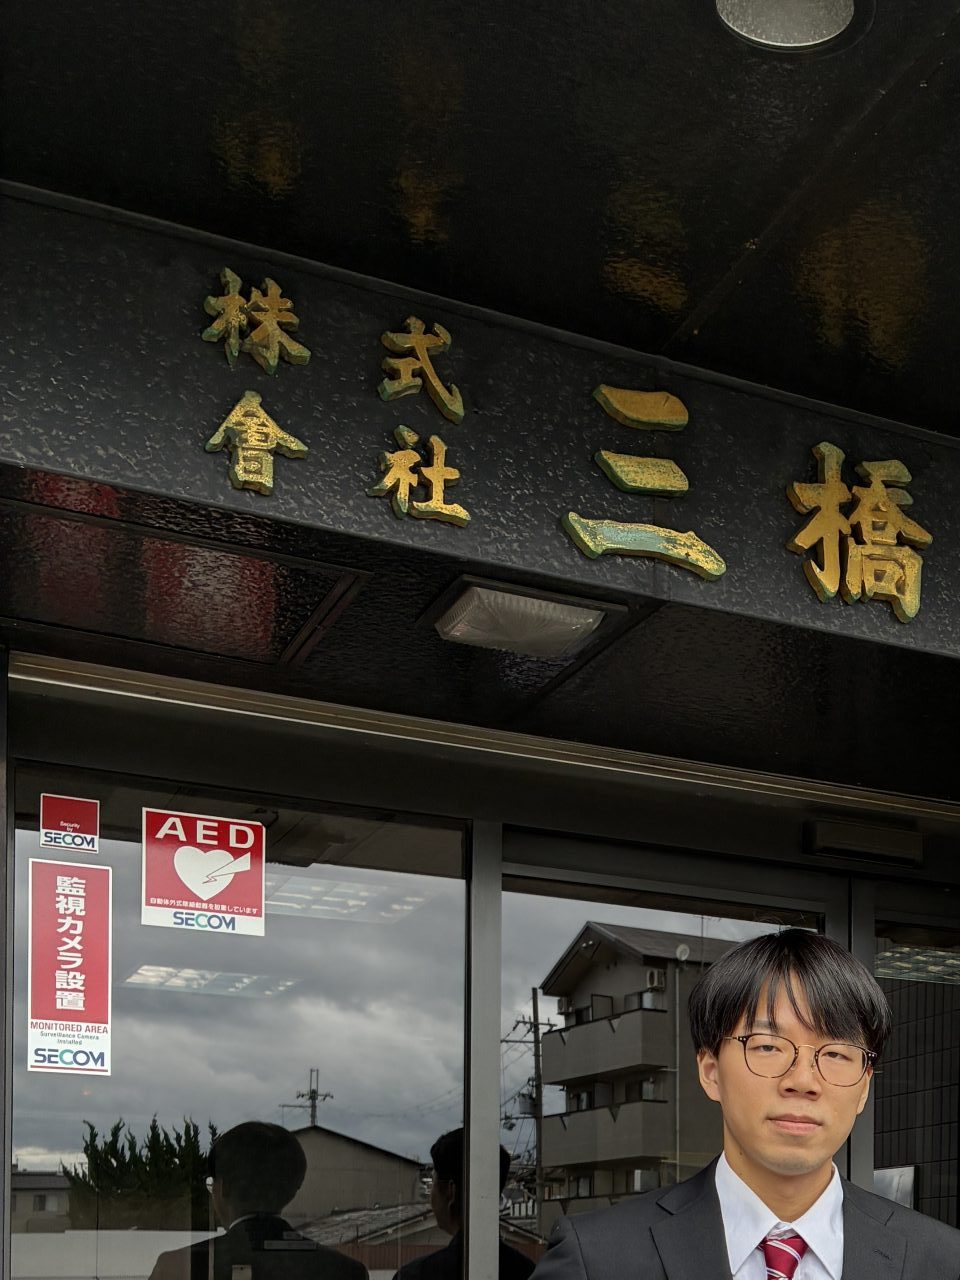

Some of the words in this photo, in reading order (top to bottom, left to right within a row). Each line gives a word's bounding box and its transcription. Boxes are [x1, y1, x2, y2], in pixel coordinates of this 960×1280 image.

[60, 820, 80, 829] Security
[155, 817, 255, 849] AED
[44, 831, 95, 849] SECOM
[173, 911, 236, 931] SECOM
[55, 875, 86, 1011] 監視カメラ設置
[30, 1021, 82, 1032] MONITORED
[85, 1025, 108, 1034] AREA
[34, 1047, 105, 1067] SECOM
